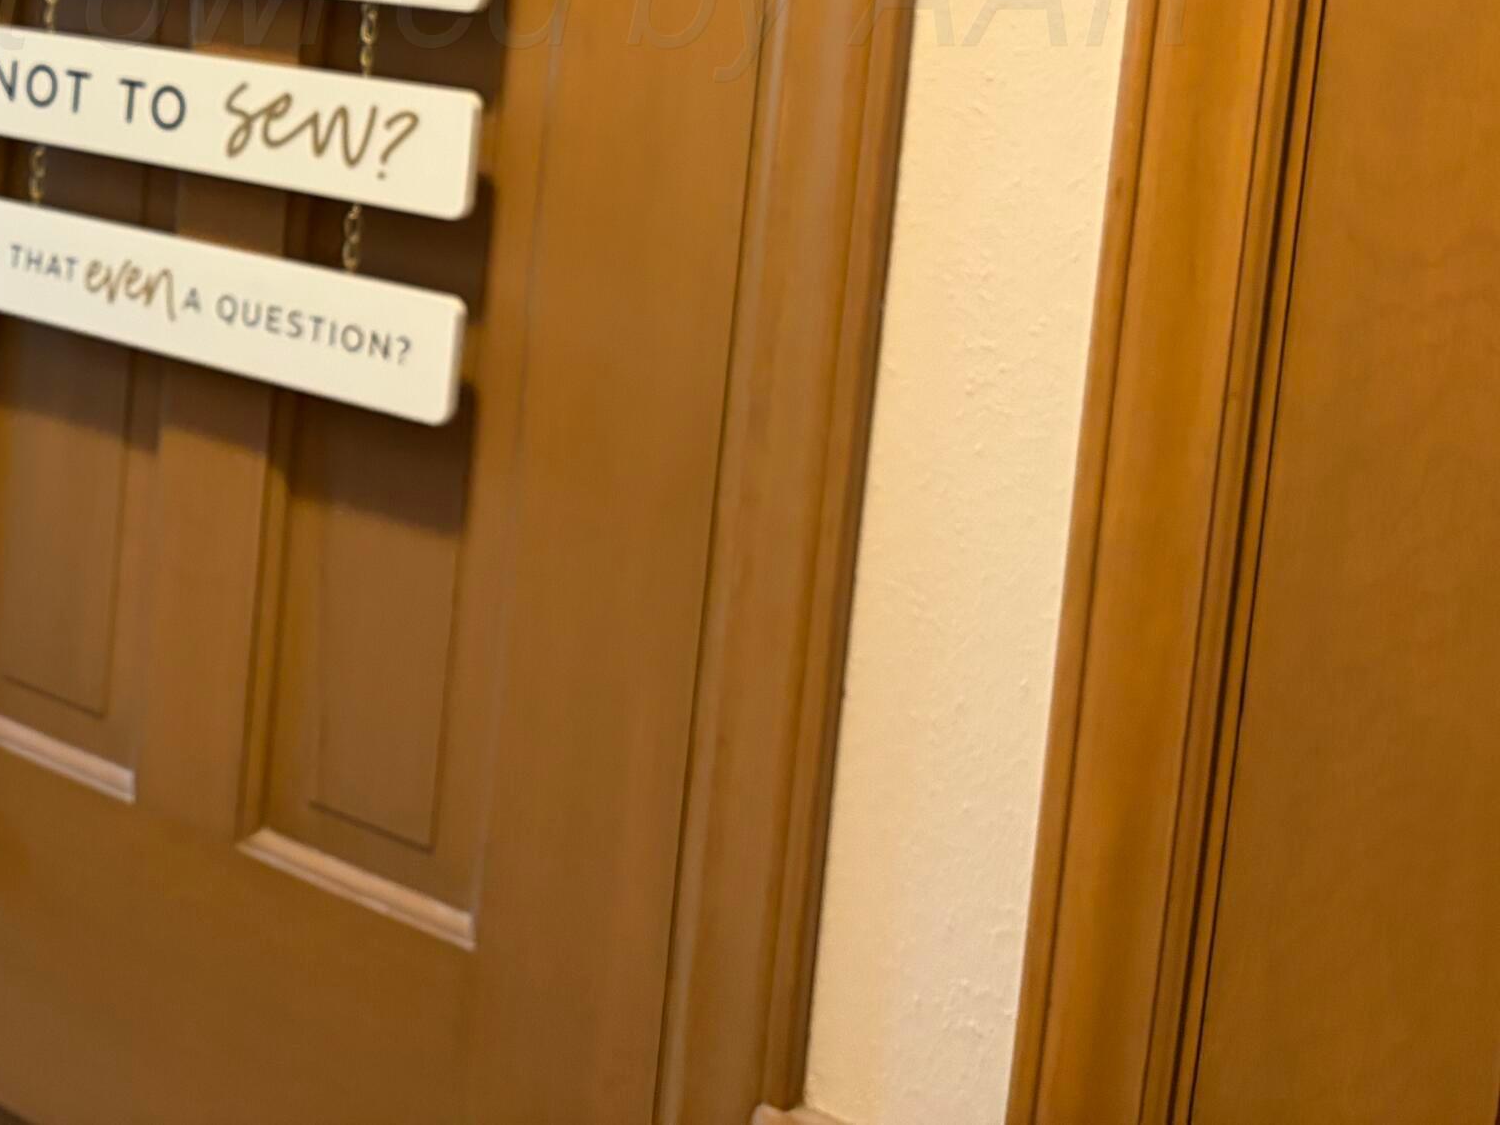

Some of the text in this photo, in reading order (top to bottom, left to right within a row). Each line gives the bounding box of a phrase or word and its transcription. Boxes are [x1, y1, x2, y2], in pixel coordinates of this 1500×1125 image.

[119, 78, 186, 131] TO
[224, 82, 419, 179] sew?
[10, 244, 78, 283] THAT
[85, 260, 178, 321] even
[183, 288, 202, 312] A
[217, 294, 412, 366] QUESTION?
